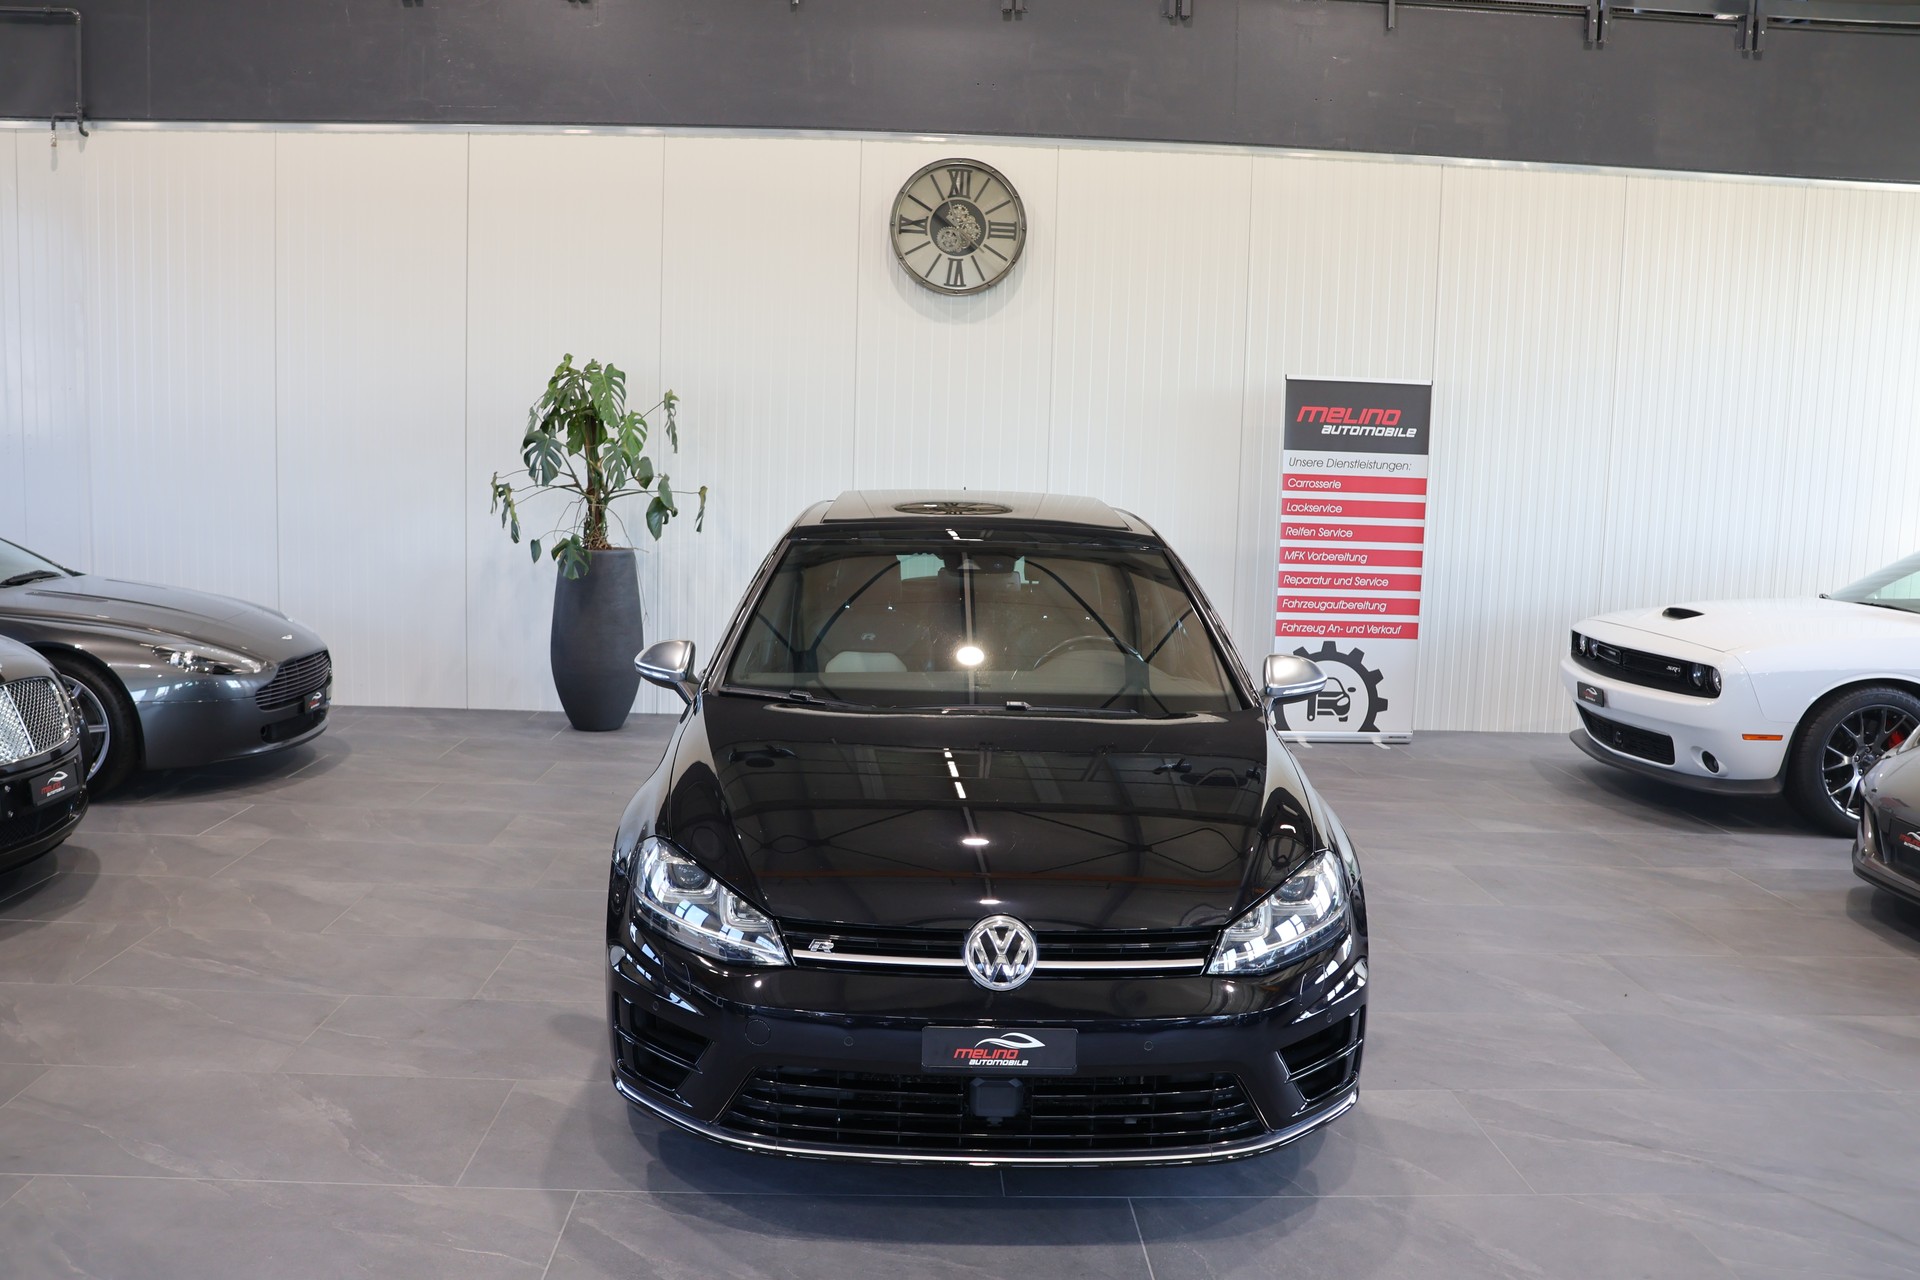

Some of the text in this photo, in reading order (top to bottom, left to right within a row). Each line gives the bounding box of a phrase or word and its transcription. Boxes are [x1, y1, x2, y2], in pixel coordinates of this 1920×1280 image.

[947, 168, 973, 200] XII
[1288, 456, 1412, 473] Unsere Dienstleistungen:
[1287, 477, 1342, 489] Carrosserie
[1286, 502, 1343, 514] Lackservice
[1285, 526, 1354, 538] Reifen Service
[1284, 550, 1368, 565] MFK Vorbereitung
[1283, 574, 1389, 587] Reparatur und Service
[1282, 598, 1387, 613] Fahrzeugaufbereitung
[1281, 622, 1402, 635] Fahrzeug An- und Verkauf
[808, 938, 835, 953] R
